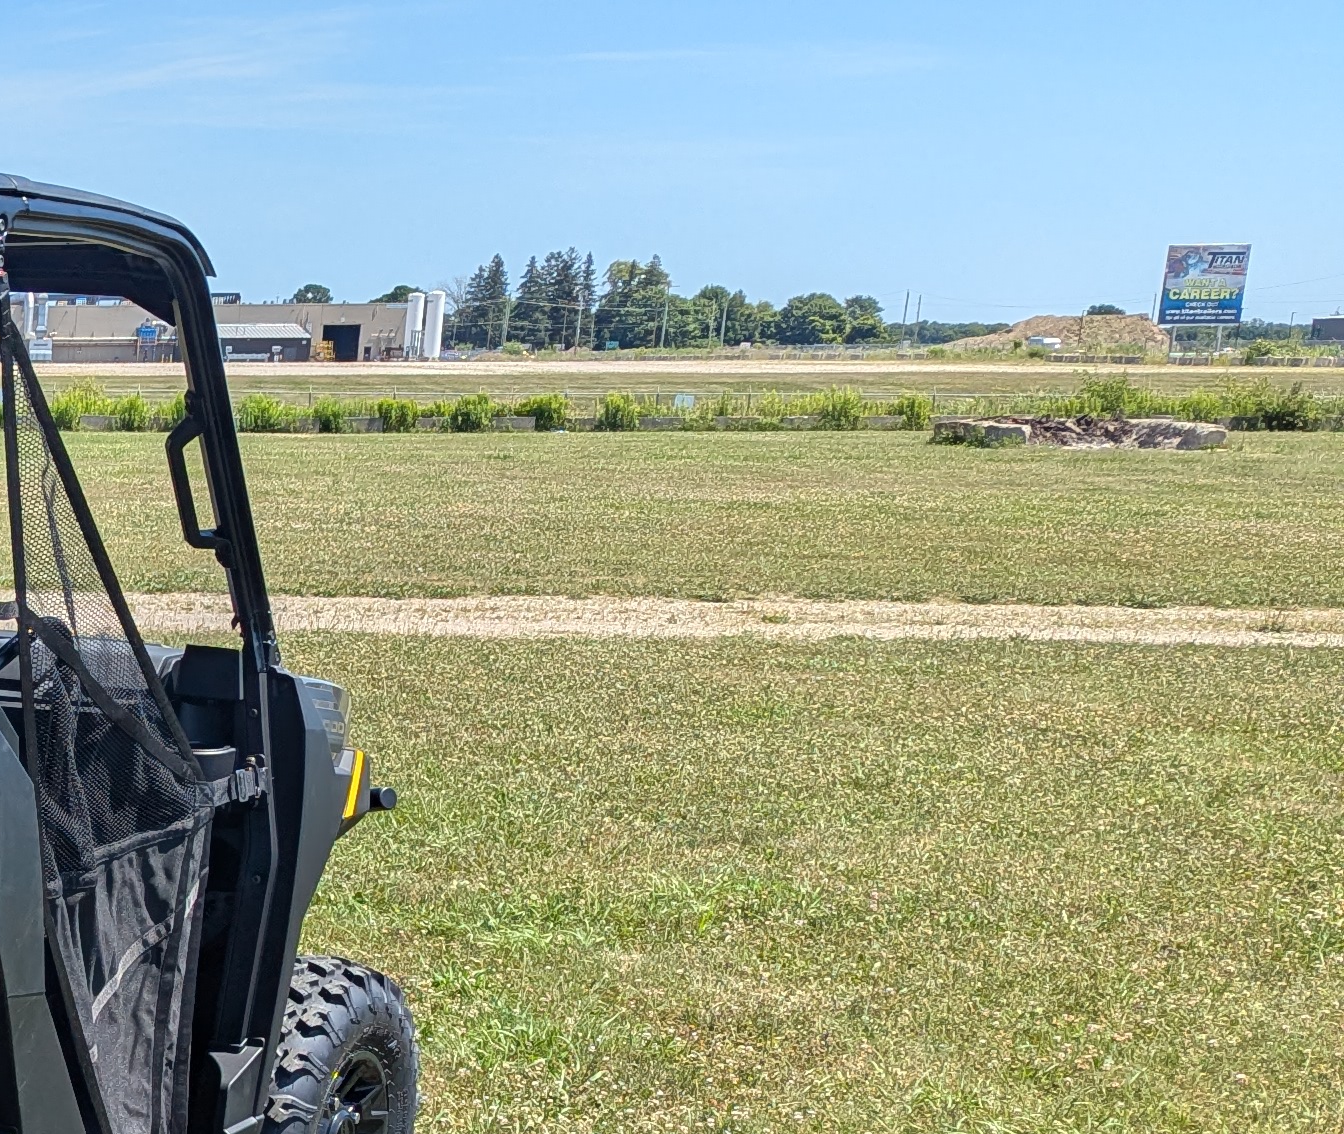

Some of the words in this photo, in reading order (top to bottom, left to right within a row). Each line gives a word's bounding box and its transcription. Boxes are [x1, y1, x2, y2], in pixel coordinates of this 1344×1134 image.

[1208, 252, 1246, 268] TITAN
[1184, 278, 1216, 287] WANT
[1169, 287, 1239, 300] CAREER?
